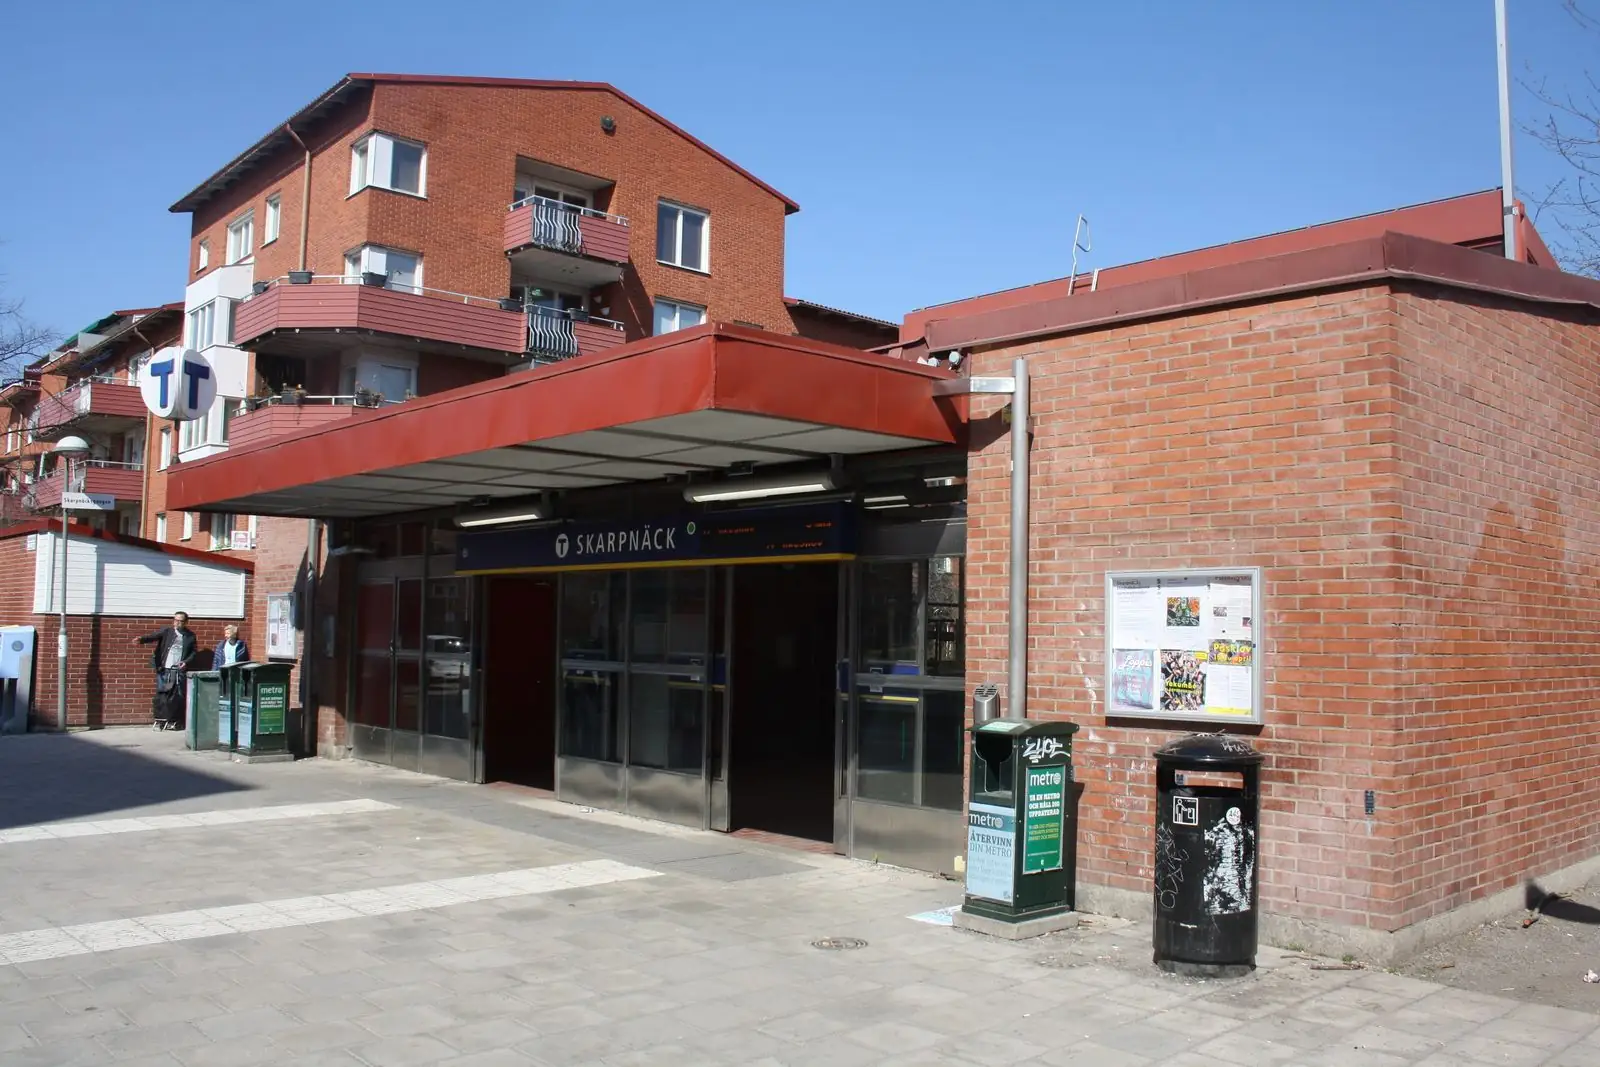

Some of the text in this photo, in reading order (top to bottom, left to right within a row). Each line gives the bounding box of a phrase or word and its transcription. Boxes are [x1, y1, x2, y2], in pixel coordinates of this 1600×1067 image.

[150, 358, 174, 409] T
[184, 360, 210, 410] T
[576, 524, 676, 554] SKARPNÄCK
[1030, 771, 1062, 787] metro
[1028, 802, 1039, 810] OCH
[1028, 808, 1060, 818] UPPDATERAD
[969, 813, 1003, 829] metro
[970, 831, 1012, 847] ÅTERVINN
[969, 842, 1012, 858] DIN METRO
